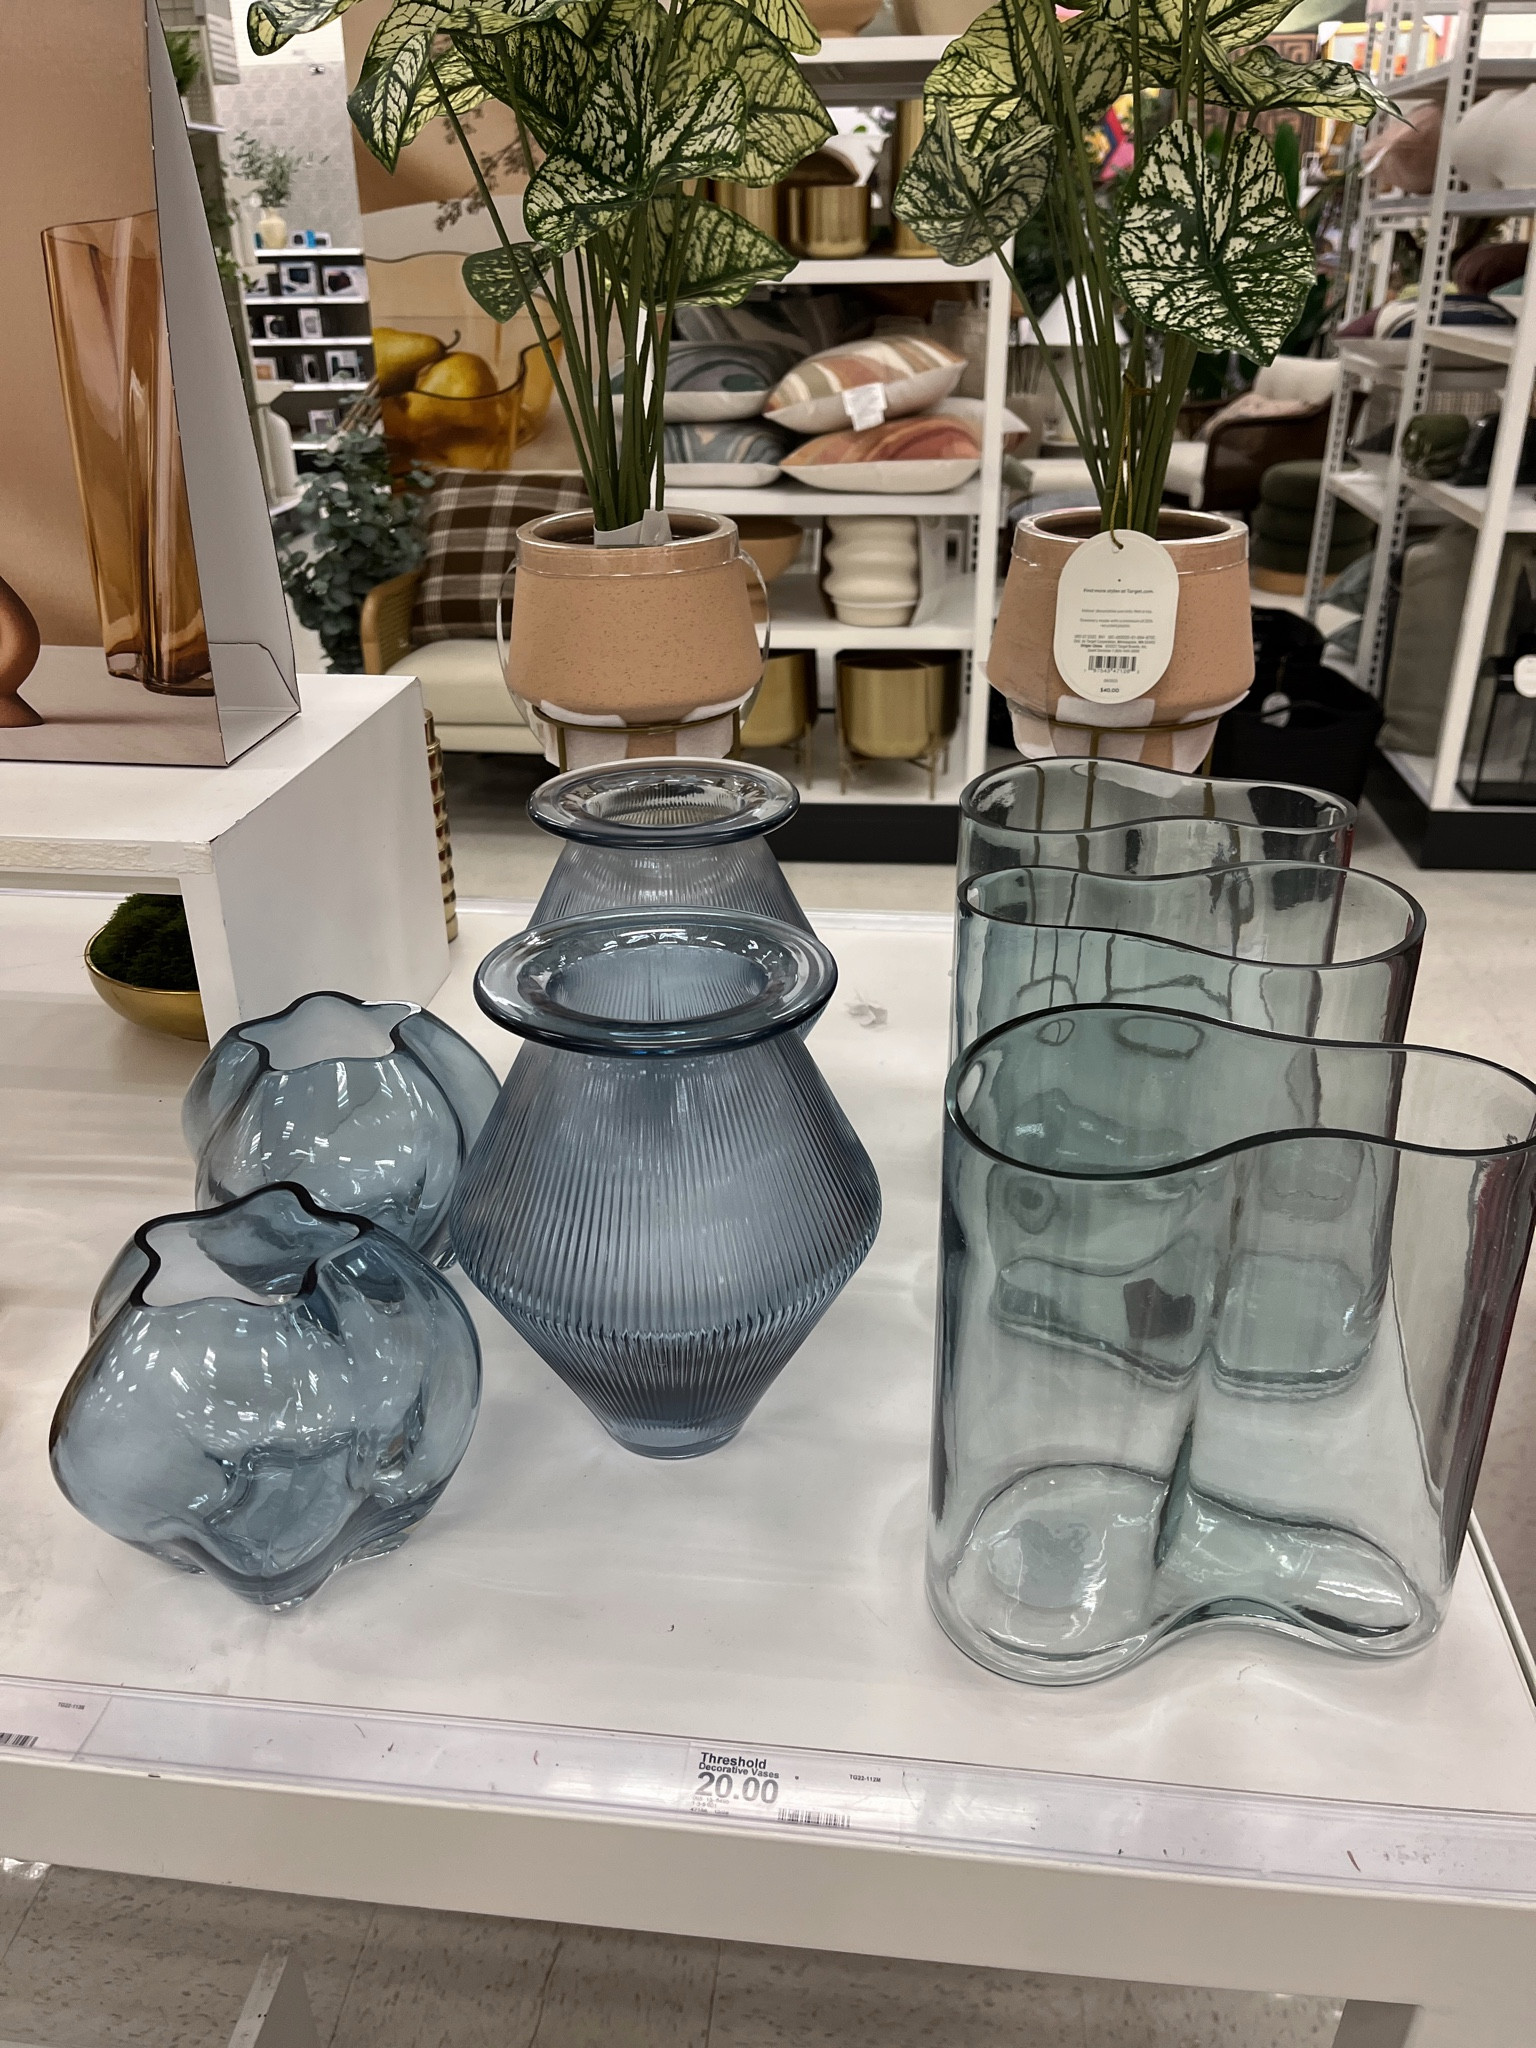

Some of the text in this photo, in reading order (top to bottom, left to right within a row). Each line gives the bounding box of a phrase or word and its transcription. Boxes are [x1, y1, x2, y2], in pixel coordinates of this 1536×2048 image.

[701, 1752, 767, 1769] Threshold
[698, 1762, 780, 1778] Decorative Vases
[694, 1771, 779, 1804] 20.00
